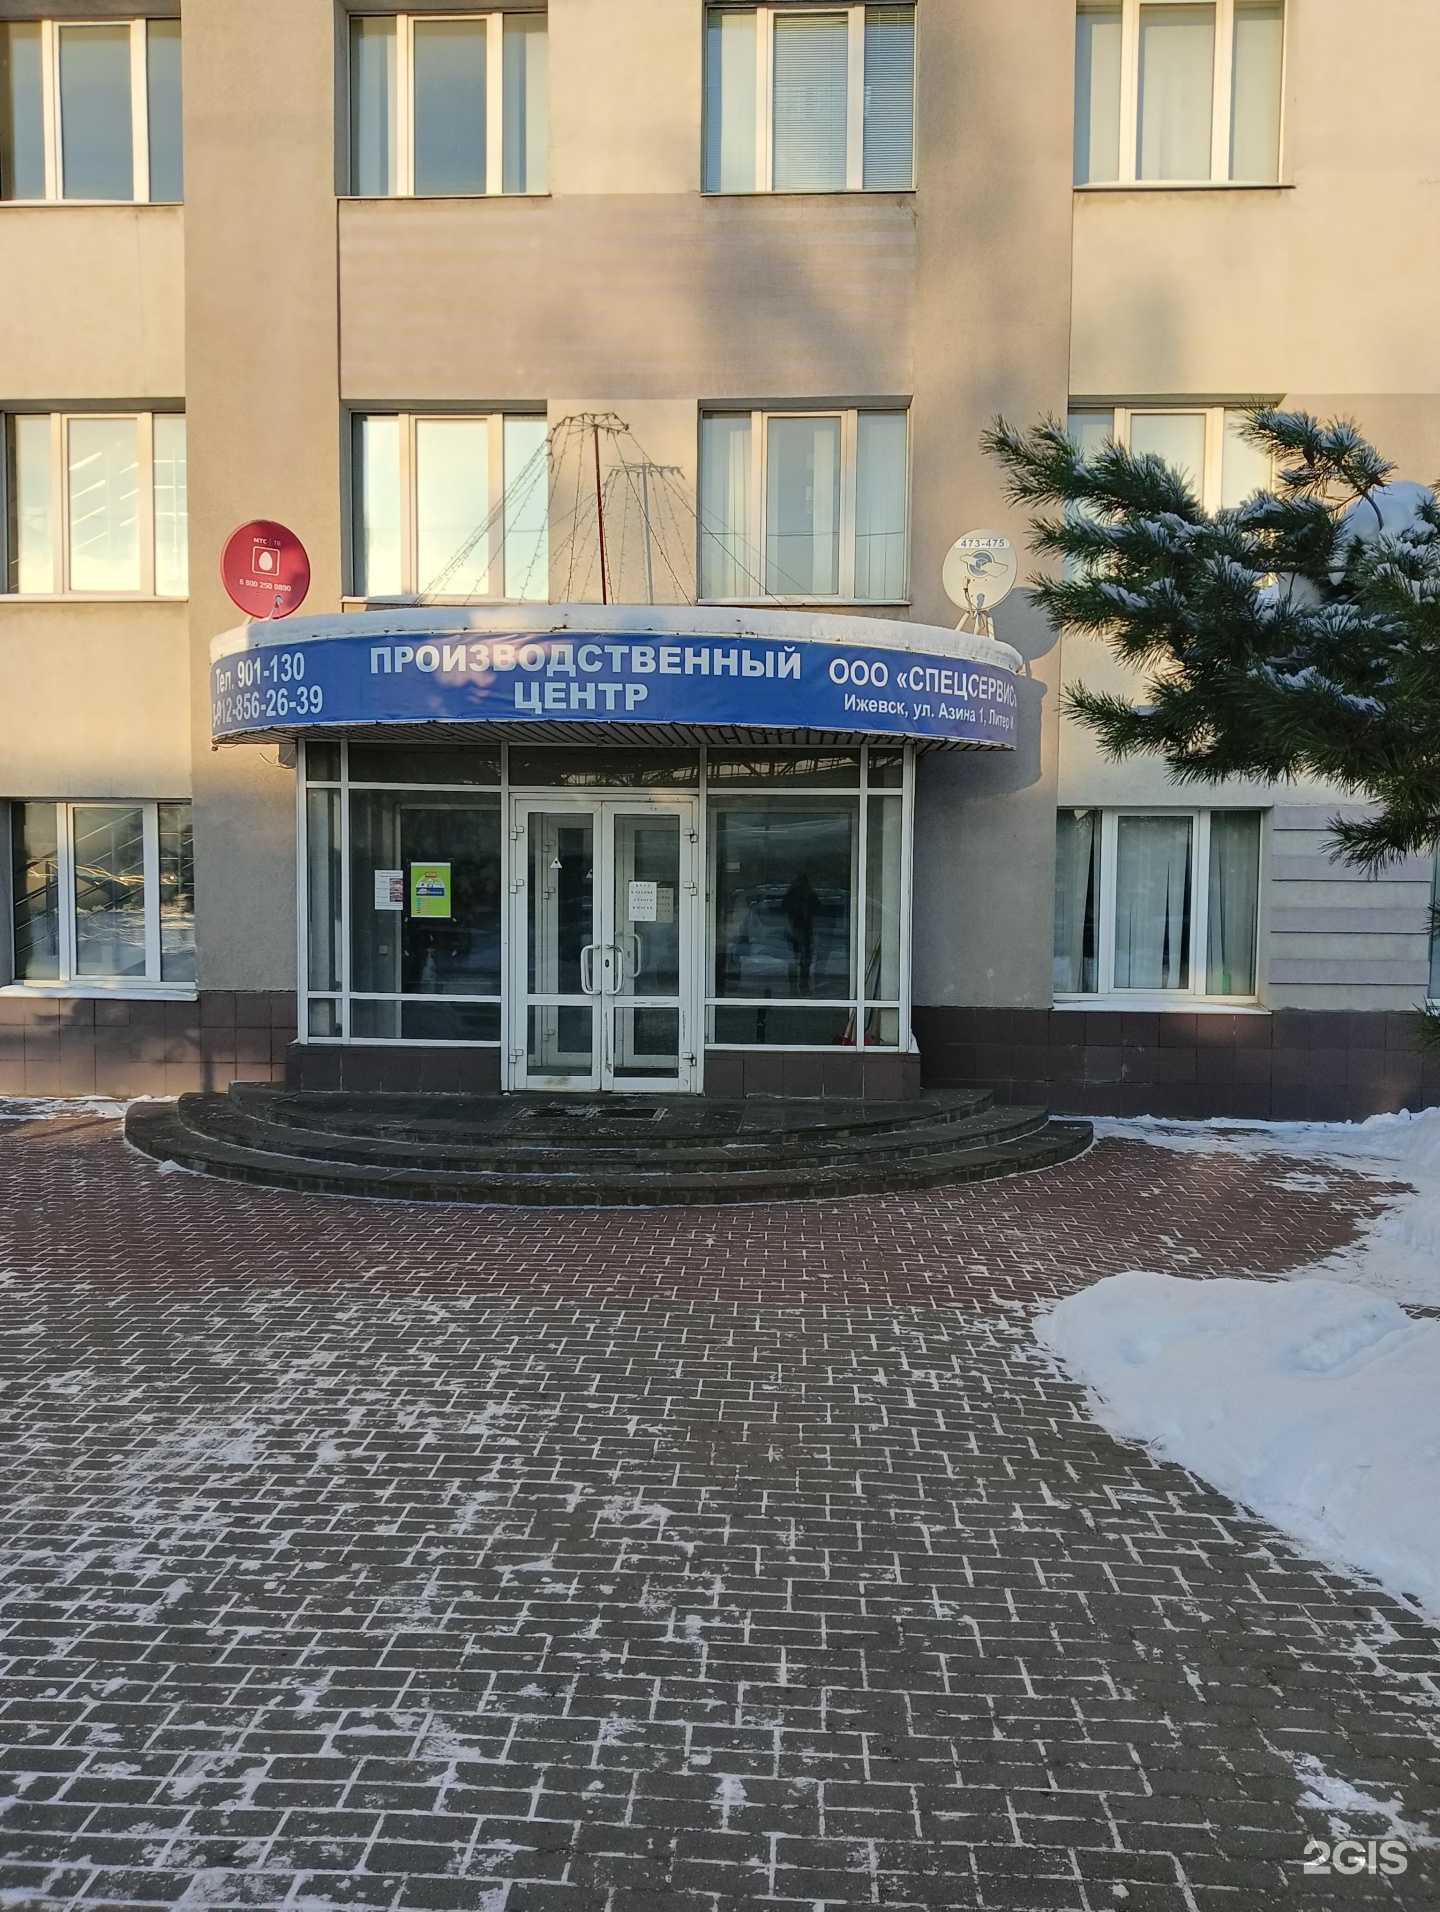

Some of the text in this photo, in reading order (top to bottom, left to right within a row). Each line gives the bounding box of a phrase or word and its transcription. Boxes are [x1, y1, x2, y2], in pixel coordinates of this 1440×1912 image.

[253, 537, 268, 545] МТС
[960, 539, 1005, 548] 473-475
[245, 579, 258, 588] 800
[259, 581, 273, 590] 250
[215, 652, 305, 695] Тел. 901-130
[370, 643, 801, 680] ПРОИЗВОДСТВЕННЫЙ
[829, 658, 889, 688] ООО
[514, 681, 649, 715] ЦЕНТР
[844, 693, 908, 718] Ижевск,
[913, 703, 935, 720] ул.
[938, 702, 976, 722] Азина
[980, 707, 987, 727] 1,
[988, 708, 1010, 732] Литер
